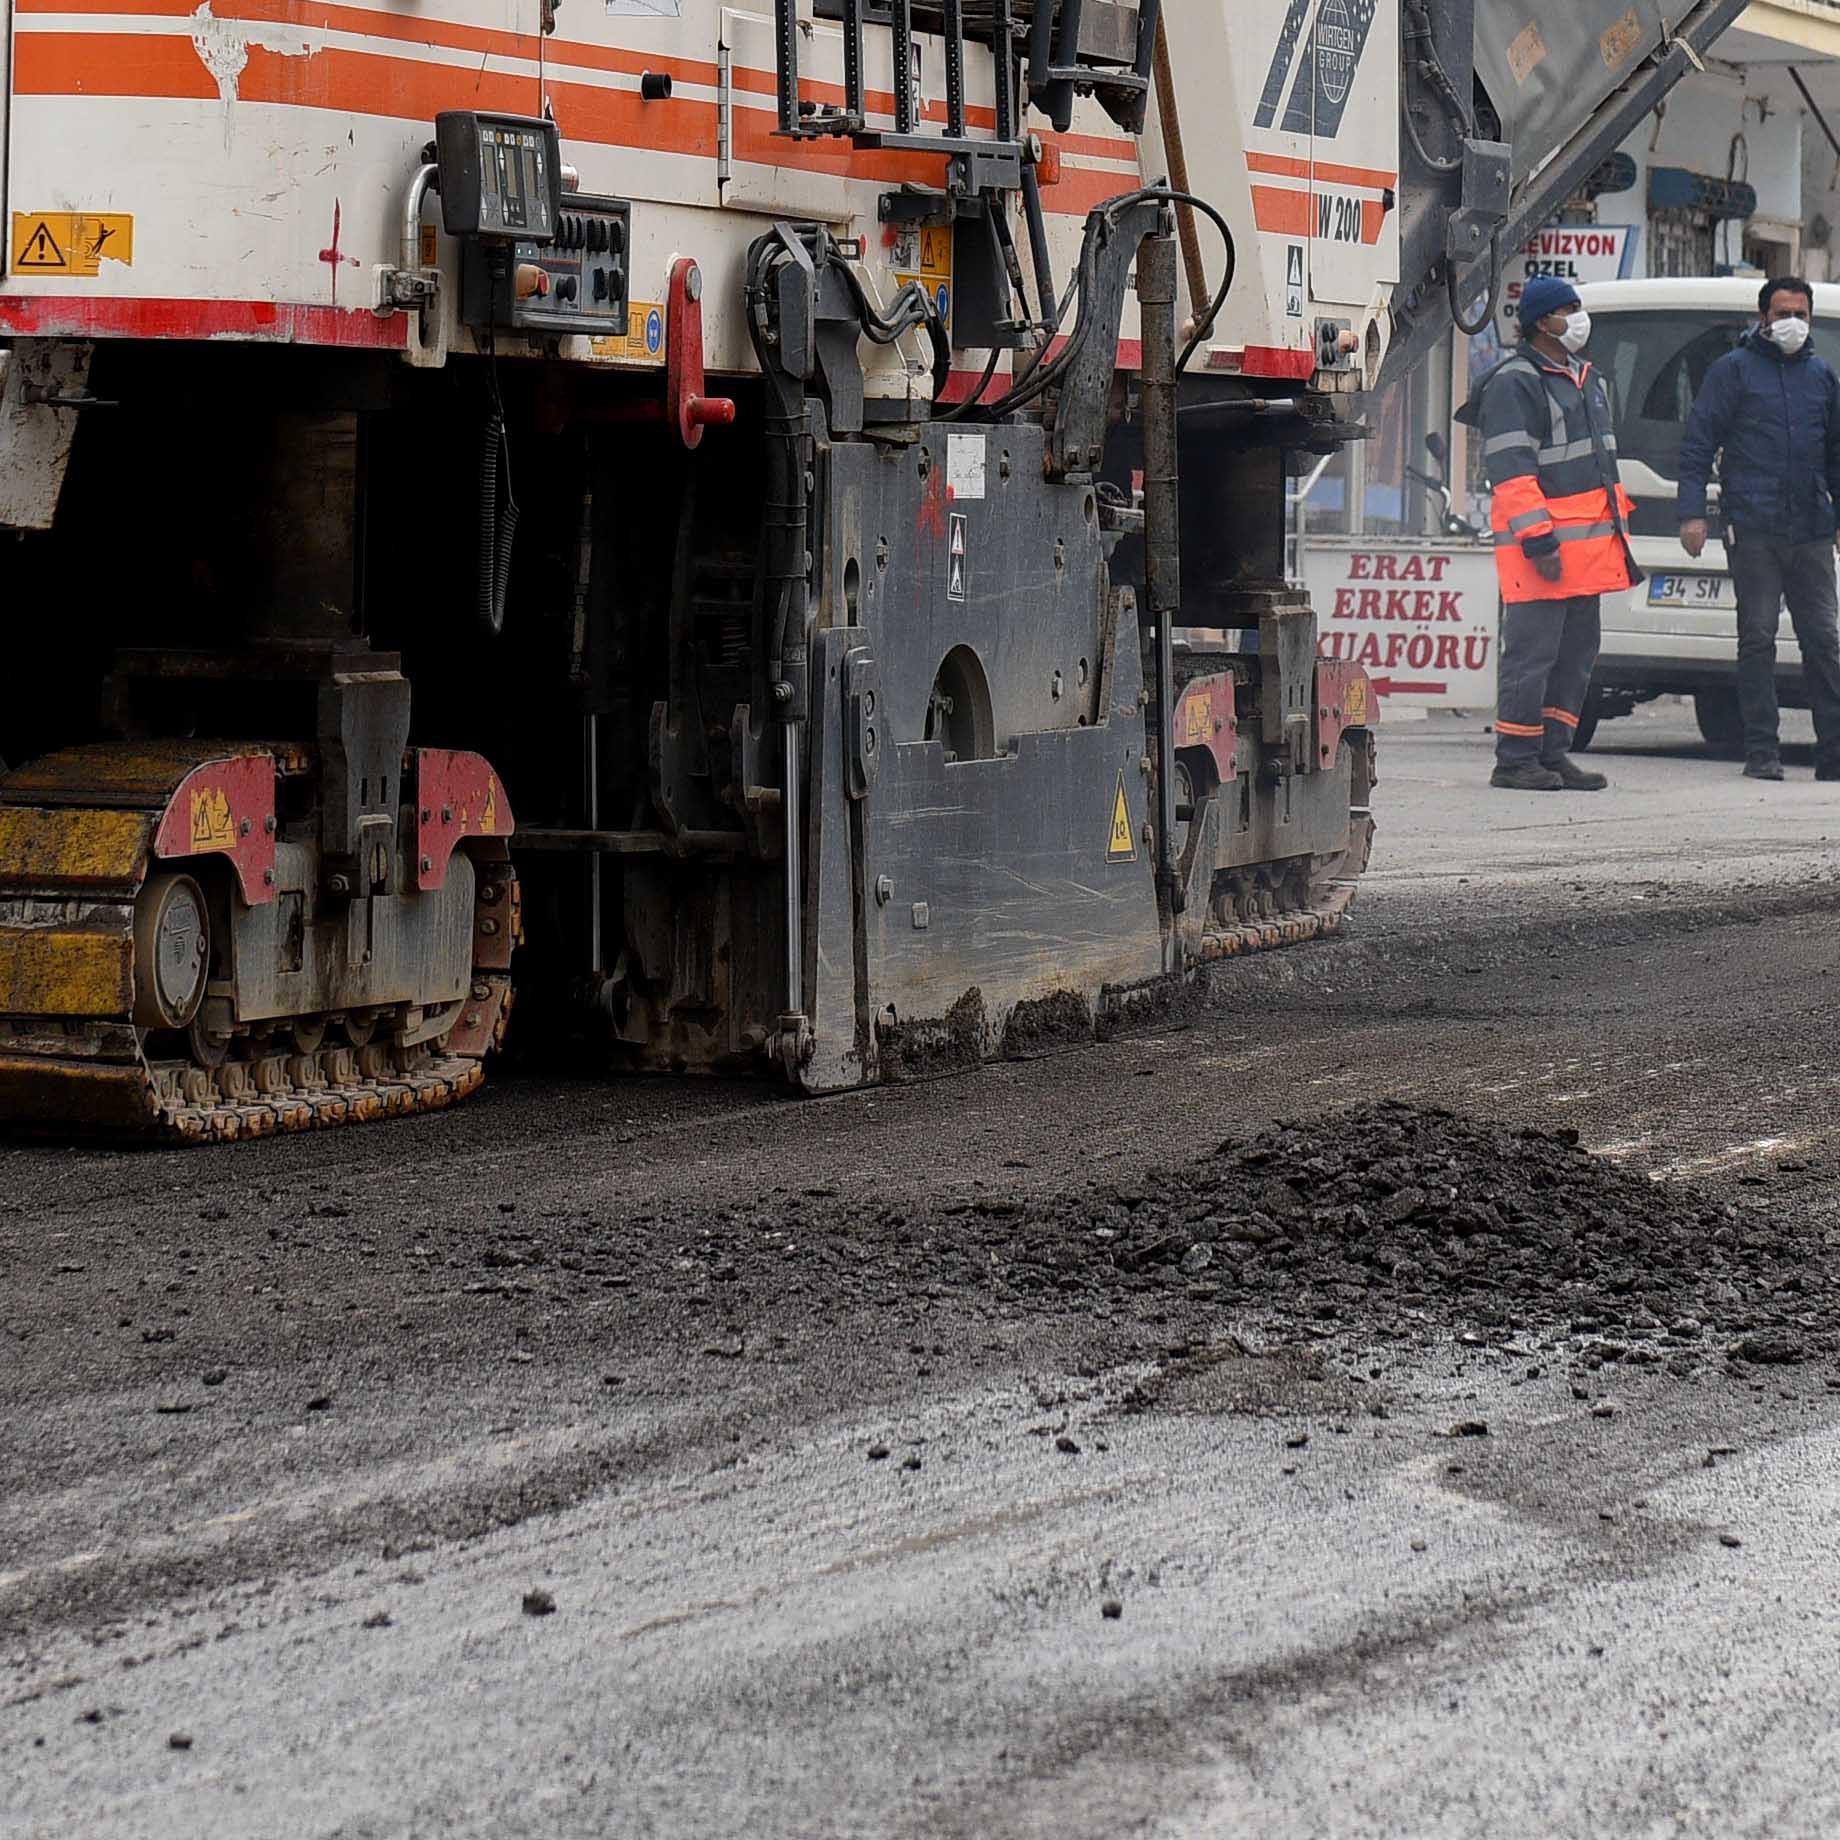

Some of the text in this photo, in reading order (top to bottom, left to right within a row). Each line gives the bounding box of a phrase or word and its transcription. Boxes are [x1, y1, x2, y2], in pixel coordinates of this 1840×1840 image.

[1317, 23, 1355, 51] WIRTGEN
[1319, 52, 1351, 71] GROUP
[1318, 193, 1361, 244] W 200
[1347, 554, 1451, 581] ERAT
[1663, 578, 1686, 598] 34
[1331, 588, 1464, 622] ERKEK
